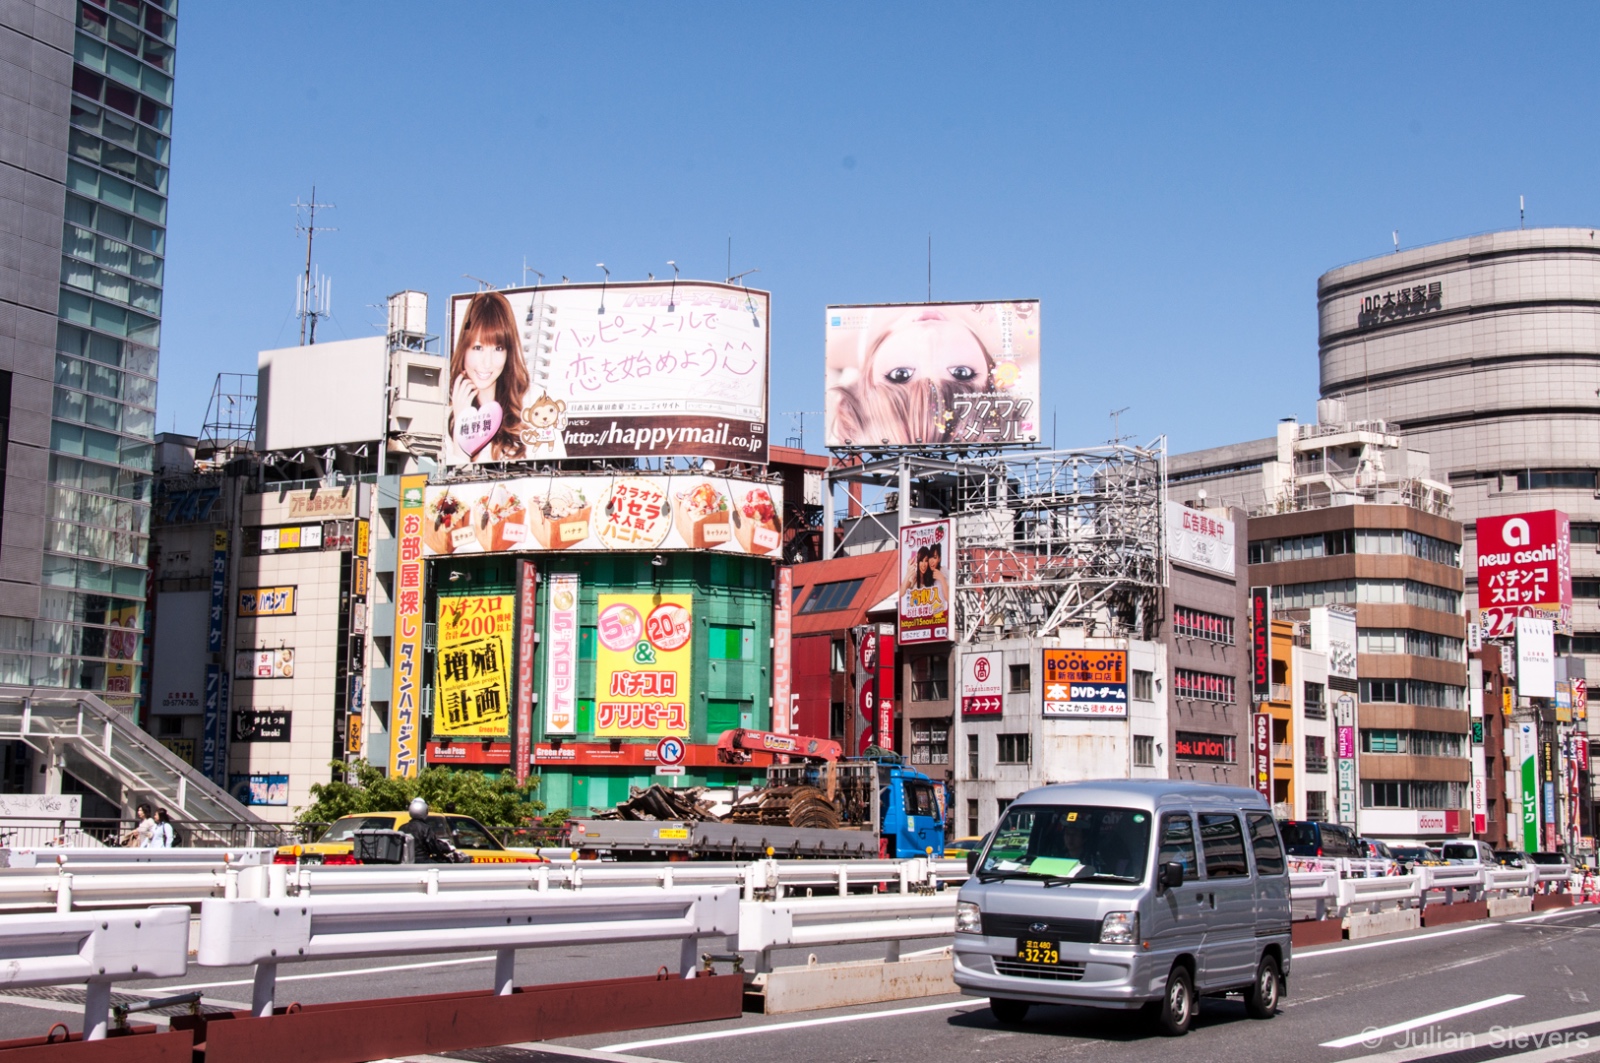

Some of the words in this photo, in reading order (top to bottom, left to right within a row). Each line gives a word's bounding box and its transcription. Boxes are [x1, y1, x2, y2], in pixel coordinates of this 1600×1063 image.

[555, 311, 719, 349] ハッピーメールで
[565, 342, 717, 395] 恋を始めよう
[953, 399, 1033, 419] ワクワク
[564, 422, 762, 452] http://happymail.co.jp
[964, 420, 1024, 440] メール
[166, 487, 220, 523] 747
[616, 484, 662, 503] カラオケ
[606, 496, 660, 520] パセラ
[602, 524, 653, 543] ハニトー
[1183, 511, 1224, 540] 広告募集中
[216, 534, 226, 547] 5F
[1479, 552, 1510, 567] new
[1514, 543, 1556, 564] asahi
[399, 514, 421, 637] お部屋探し
[1488, 567, 1549, 588] パチンコ
[210, 556, 224, 645] カラオケ
[523, 563, 535, 619] パチスロ
[779, 569, 790, 621] パチスロ
[910, 587, 941, 607] 高収入
[1491, 584, 1545, 604] スロット
[440, 597, 502, 618] パチスロ
[1256, 596, 1265, 626] disk
[460, 615, 496, 639] 200
[496, 623, 511, 632] 以上
[600, 613, 635, 640] 5円
[648, 613, 687, 641] 20円
[1192, 614, 1223, 633] union
[553, 611, 573, 712] 5円スロット
[634, 640, 656, 664] &
[1255, 627, 1268, 685] union
[520, 624, 534, 734] グリンピース
[610, 670, 677, 696] パチスロ
[965, 684, 1000, 693] Takashimaya
[1192, 675, 1224, 693] union
[206, 673, 218, 730] 747
[447, 682, 501, 724] 計画
[1047, 683, 1067, 700] 本
[396, 642, 416, 778] タウンハウジング
[598, 702, 687, 730] グリンピース
[1258, 716, 1267, 751] GOLD
[434, 746, 451, 755] Green
[452, 746, 466, 755] Peas
[536, 748, 558, 756] Green
[558, 748, 575, 756] Peas
[1175, 740, 1192, 755] disk
[1193, 739, 1224, 757] union
[1259, 755, 1267, 790] RUSH
[1523, 790, 1535, 824] レイク
[1420, 816, 1443, 828] docomo
[1025, 948, 1058, 964] 32-29
[1039, 941, 1051, 949] 480
